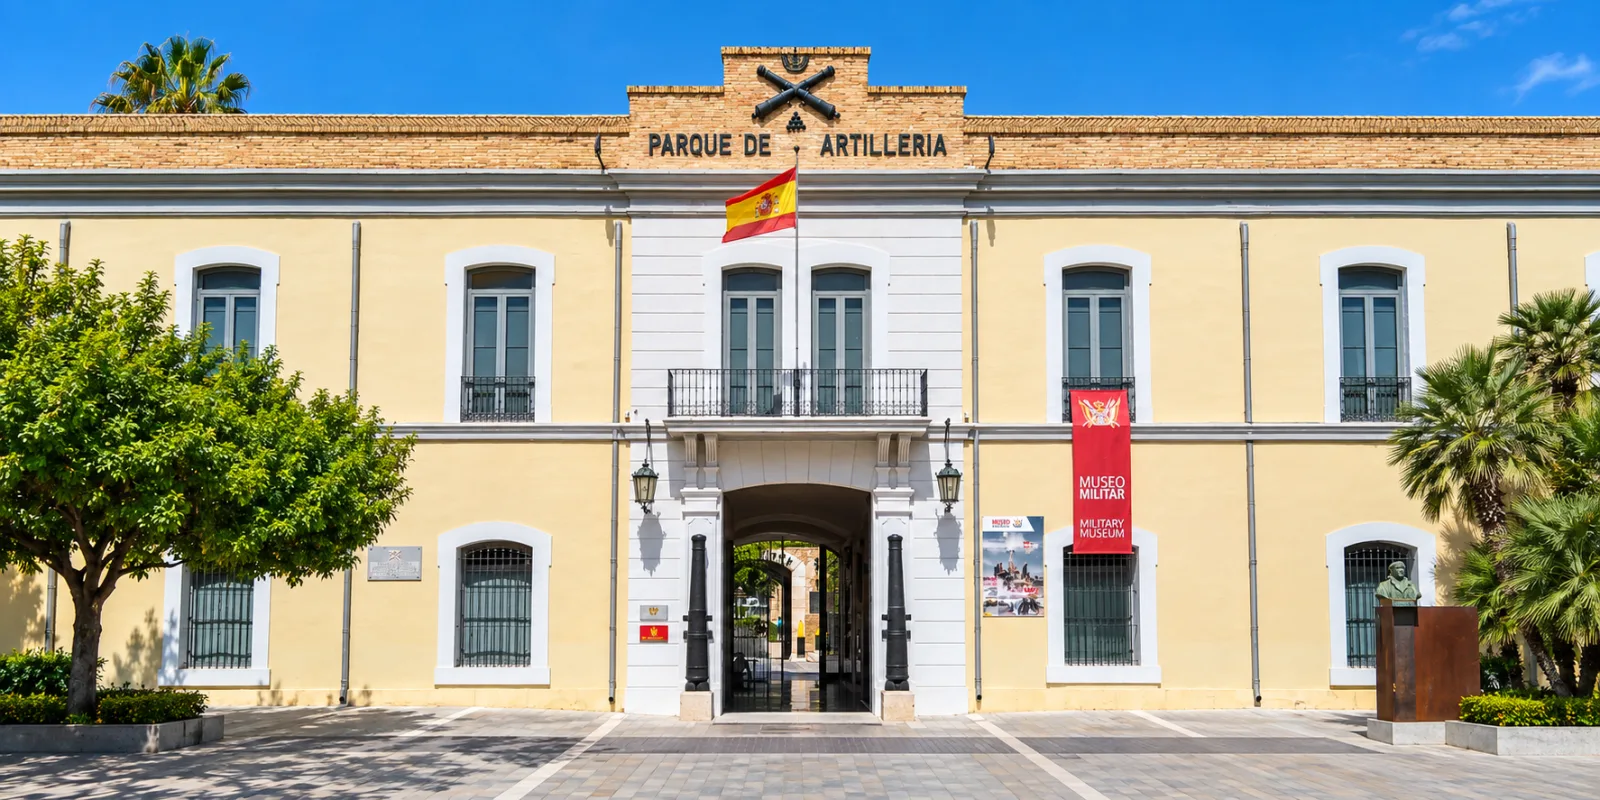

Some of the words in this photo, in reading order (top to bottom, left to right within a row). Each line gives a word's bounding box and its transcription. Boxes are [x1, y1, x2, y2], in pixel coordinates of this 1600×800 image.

[648, 133, 732, 157] PARQUE
[744, 133, 771, 156] DE
[820, 133, 947, 156] ARTILLERIA
[1079, 476, 1125, 488] MUSEO
[1079, 489, 1125, 499] MILITAR
[1080, 519, 1125, 528] MILITARY
[1080, 529, 1125, 538] MUSEUM
